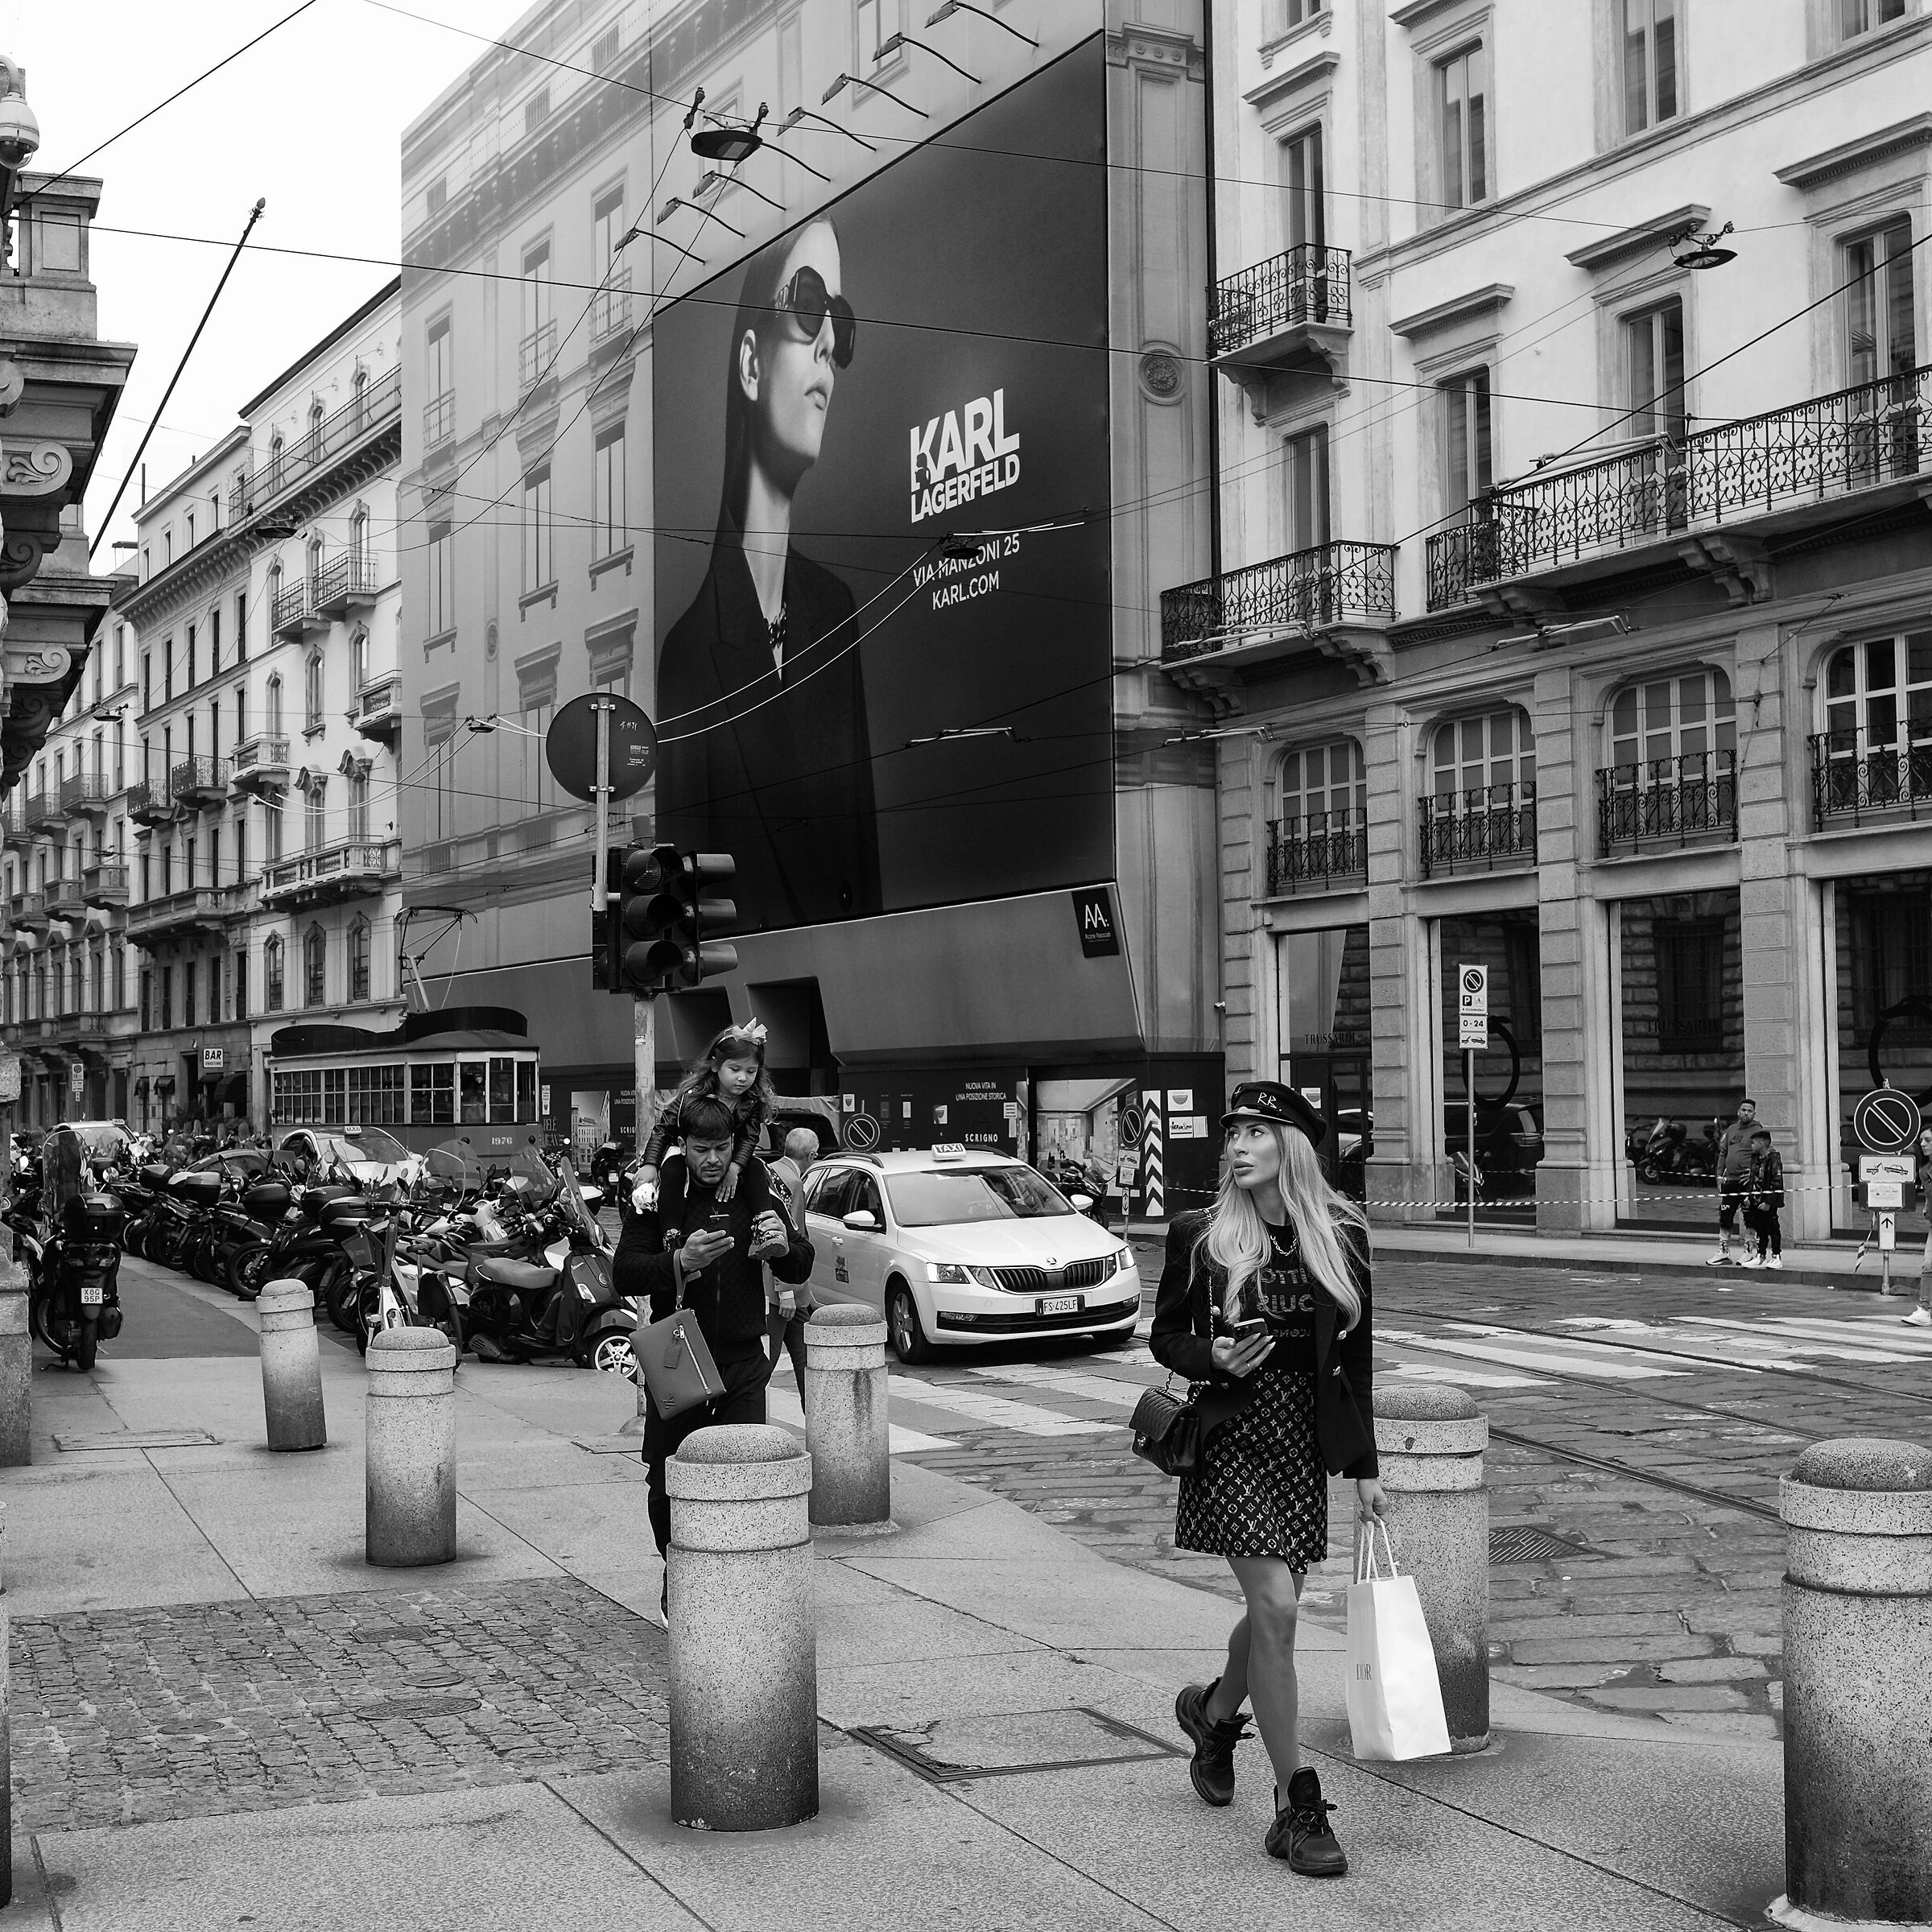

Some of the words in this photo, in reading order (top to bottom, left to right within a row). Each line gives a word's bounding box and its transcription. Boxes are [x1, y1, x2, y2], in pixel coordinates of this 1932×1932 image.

[910, 388, 1020, 493] KARL
[911, 454, 1020, 522] LAGERFELD
[913, 564, 935, 587] VIA
[1004, 533, 1020, 556] 25
[933, 571, 999, 610] KARL.COM
[1305, 1033, 1356, 1045] TRUSSARDI
[205, 1051, 221, 1059] BAR
[492, 1137, 513, 1145] 1976
[965, 1133, 998, 1142] SCRIGNO
[935, 1144, 962, 1153] TAXI
